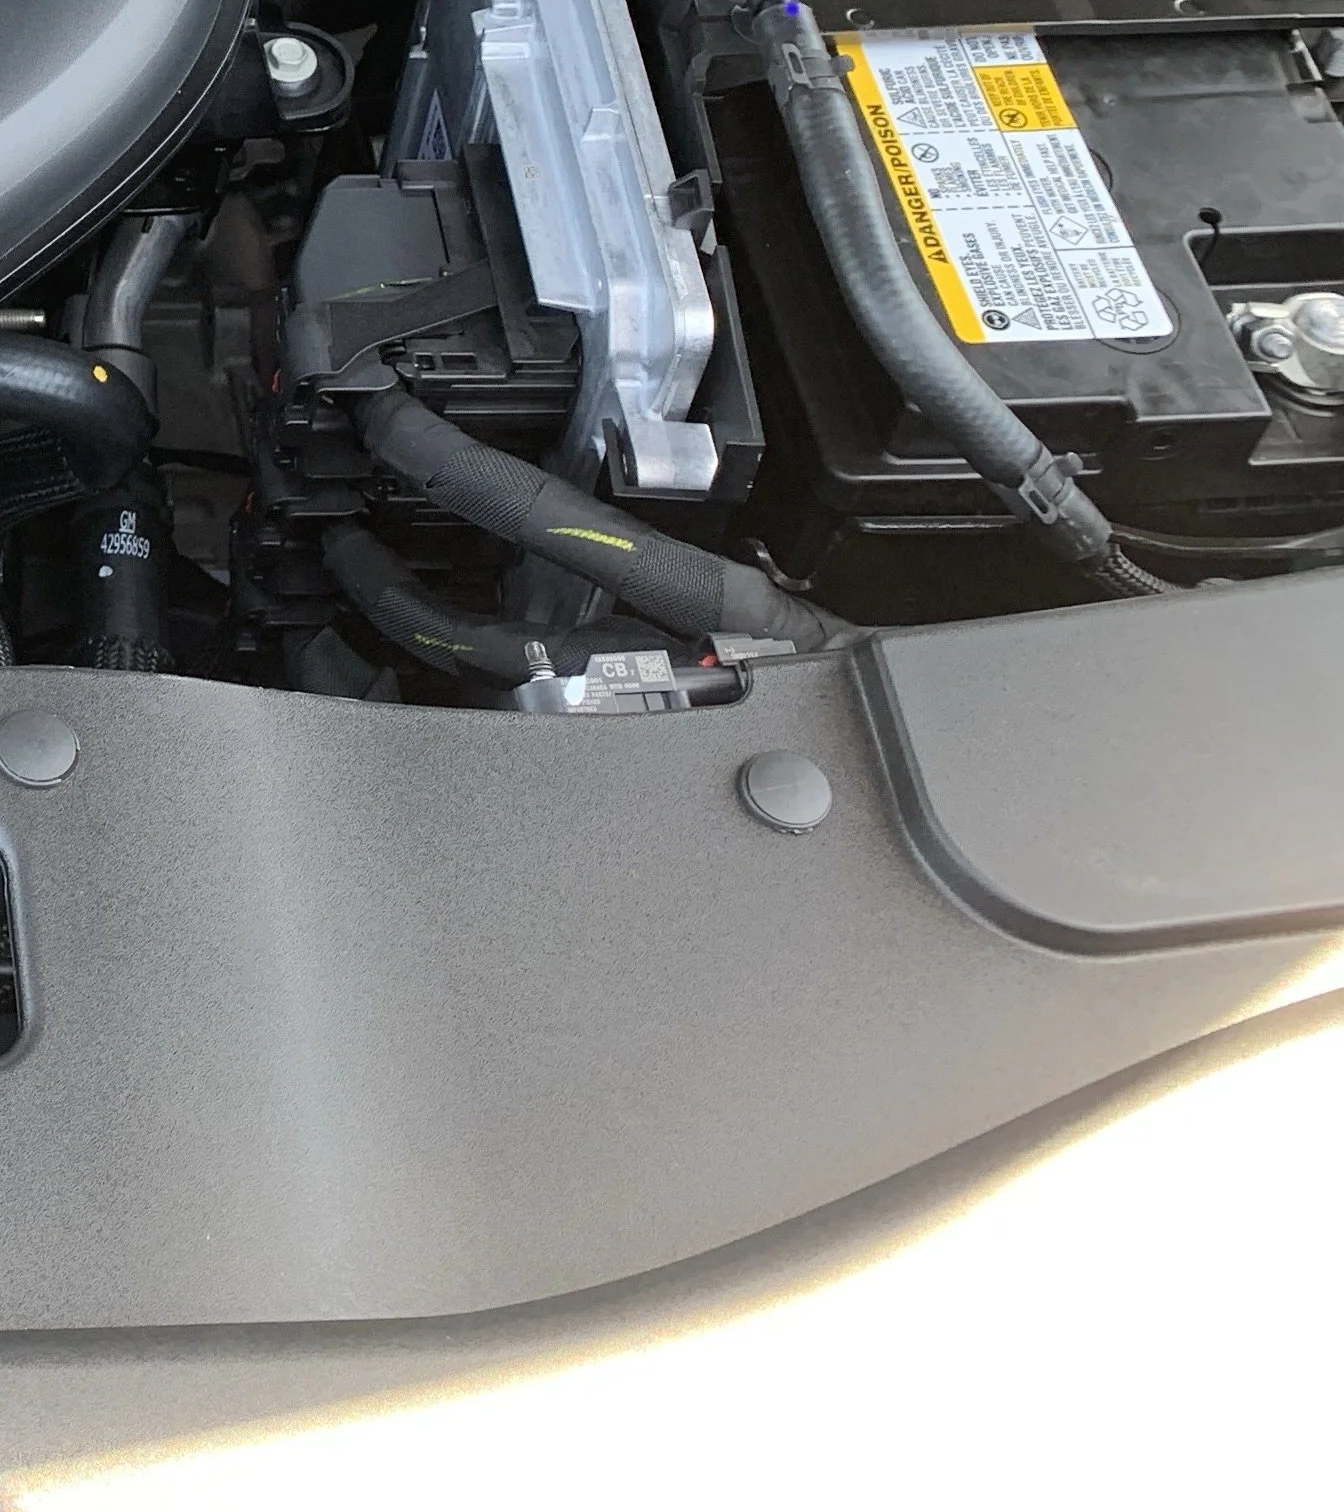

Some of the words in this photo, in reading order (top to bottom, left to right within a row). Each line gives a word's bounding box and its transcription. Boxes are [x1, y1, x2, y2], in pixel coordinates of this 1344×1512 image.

[866, 104, 941, 247] DANGER/POISON
[1010, 213, 1035, 247] PEUVENT
[961, 232, 984, 259] GASES
[975, 262, 1005, 306] EXPLOSIVE
[1026, 249, 1056, 293] EXPLOSIFS
[968, 278, 992, 307] SHIELD
[1046, 295, 1065, 312] GAZ
[119, 510, 137, 533] GM
[100, 533, 150, 559] 42956859
[602, 662, 629, 678] CB
